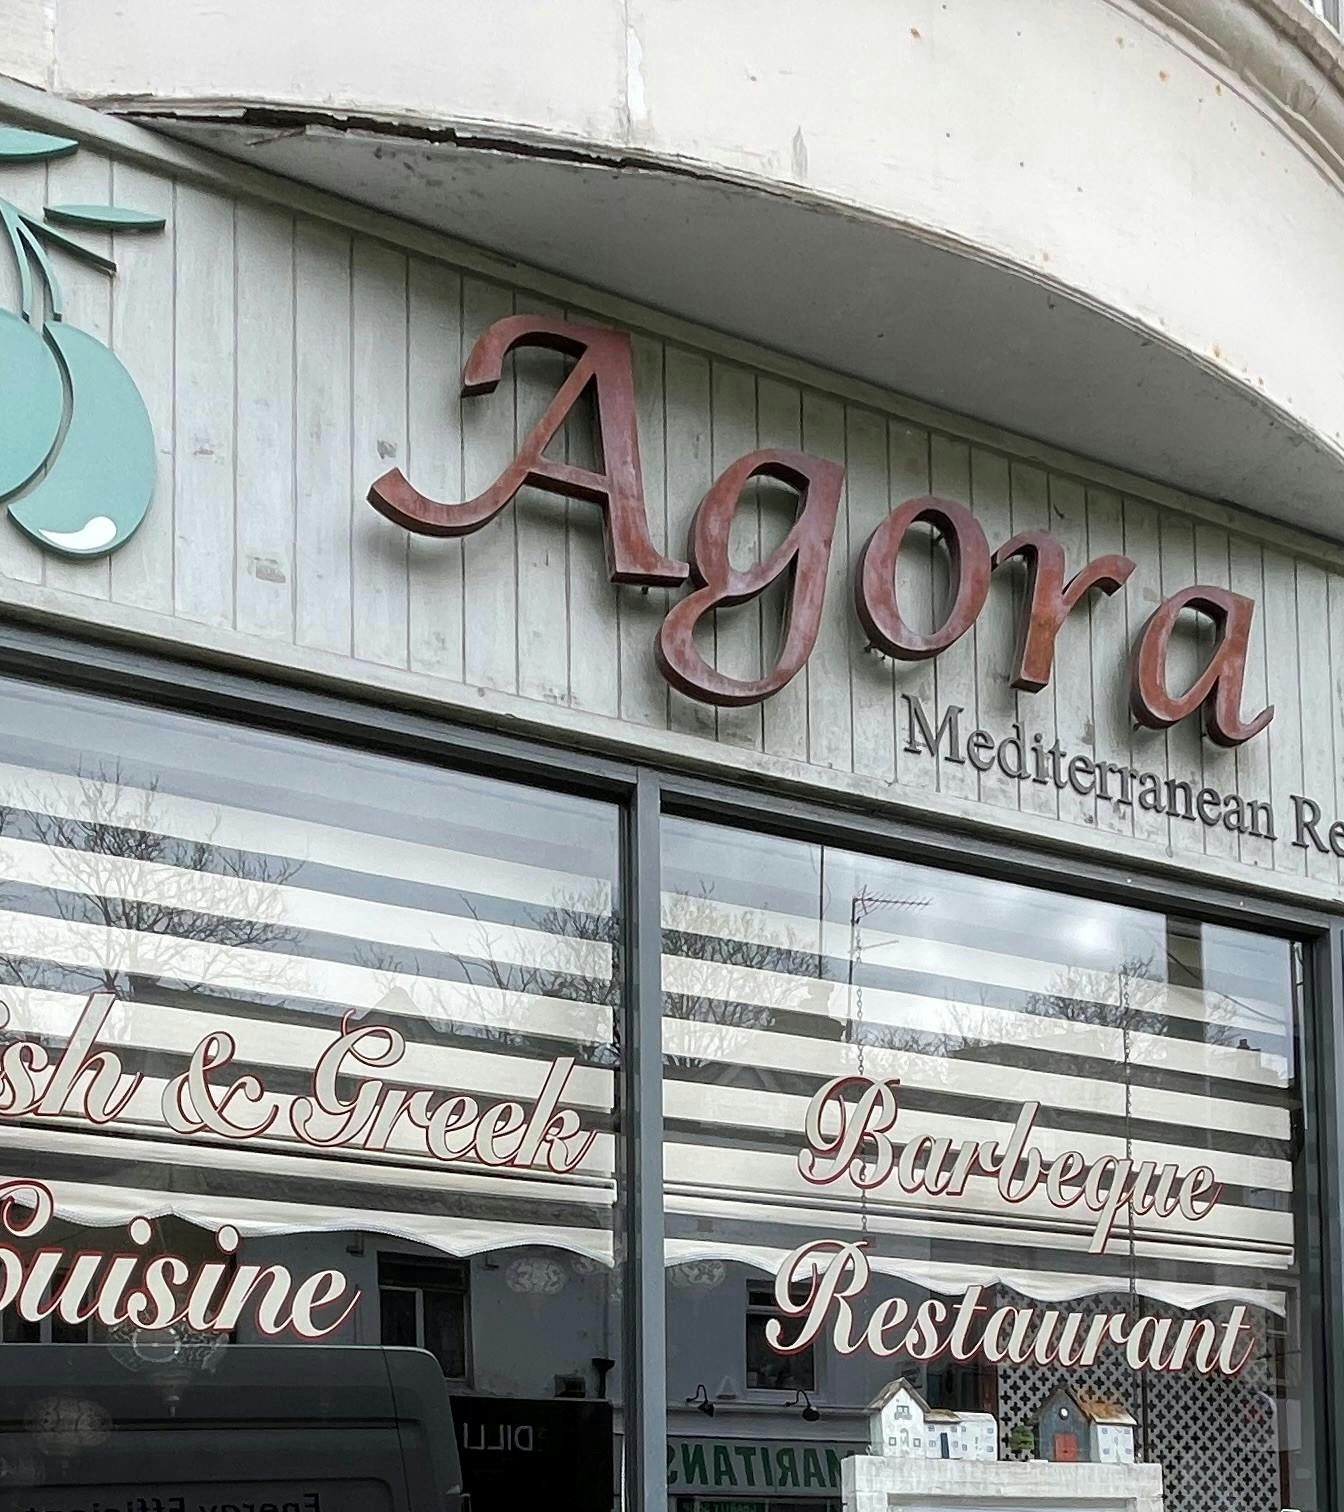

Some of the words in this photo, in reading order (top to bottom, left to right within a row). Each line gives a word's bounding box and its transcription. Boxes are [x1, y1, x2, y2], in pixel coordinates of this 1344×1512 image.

[366, 313, 1275, 748] Agora
[901, 694, 1278, 844] Mediterranean
[162, 1030, 278, 1138] &
[290, 1007, 598, 1174] Greek
[797, 1075, 1222, 1254] Barbeque
[765, 1239, 1257, 1376] Restaurant
